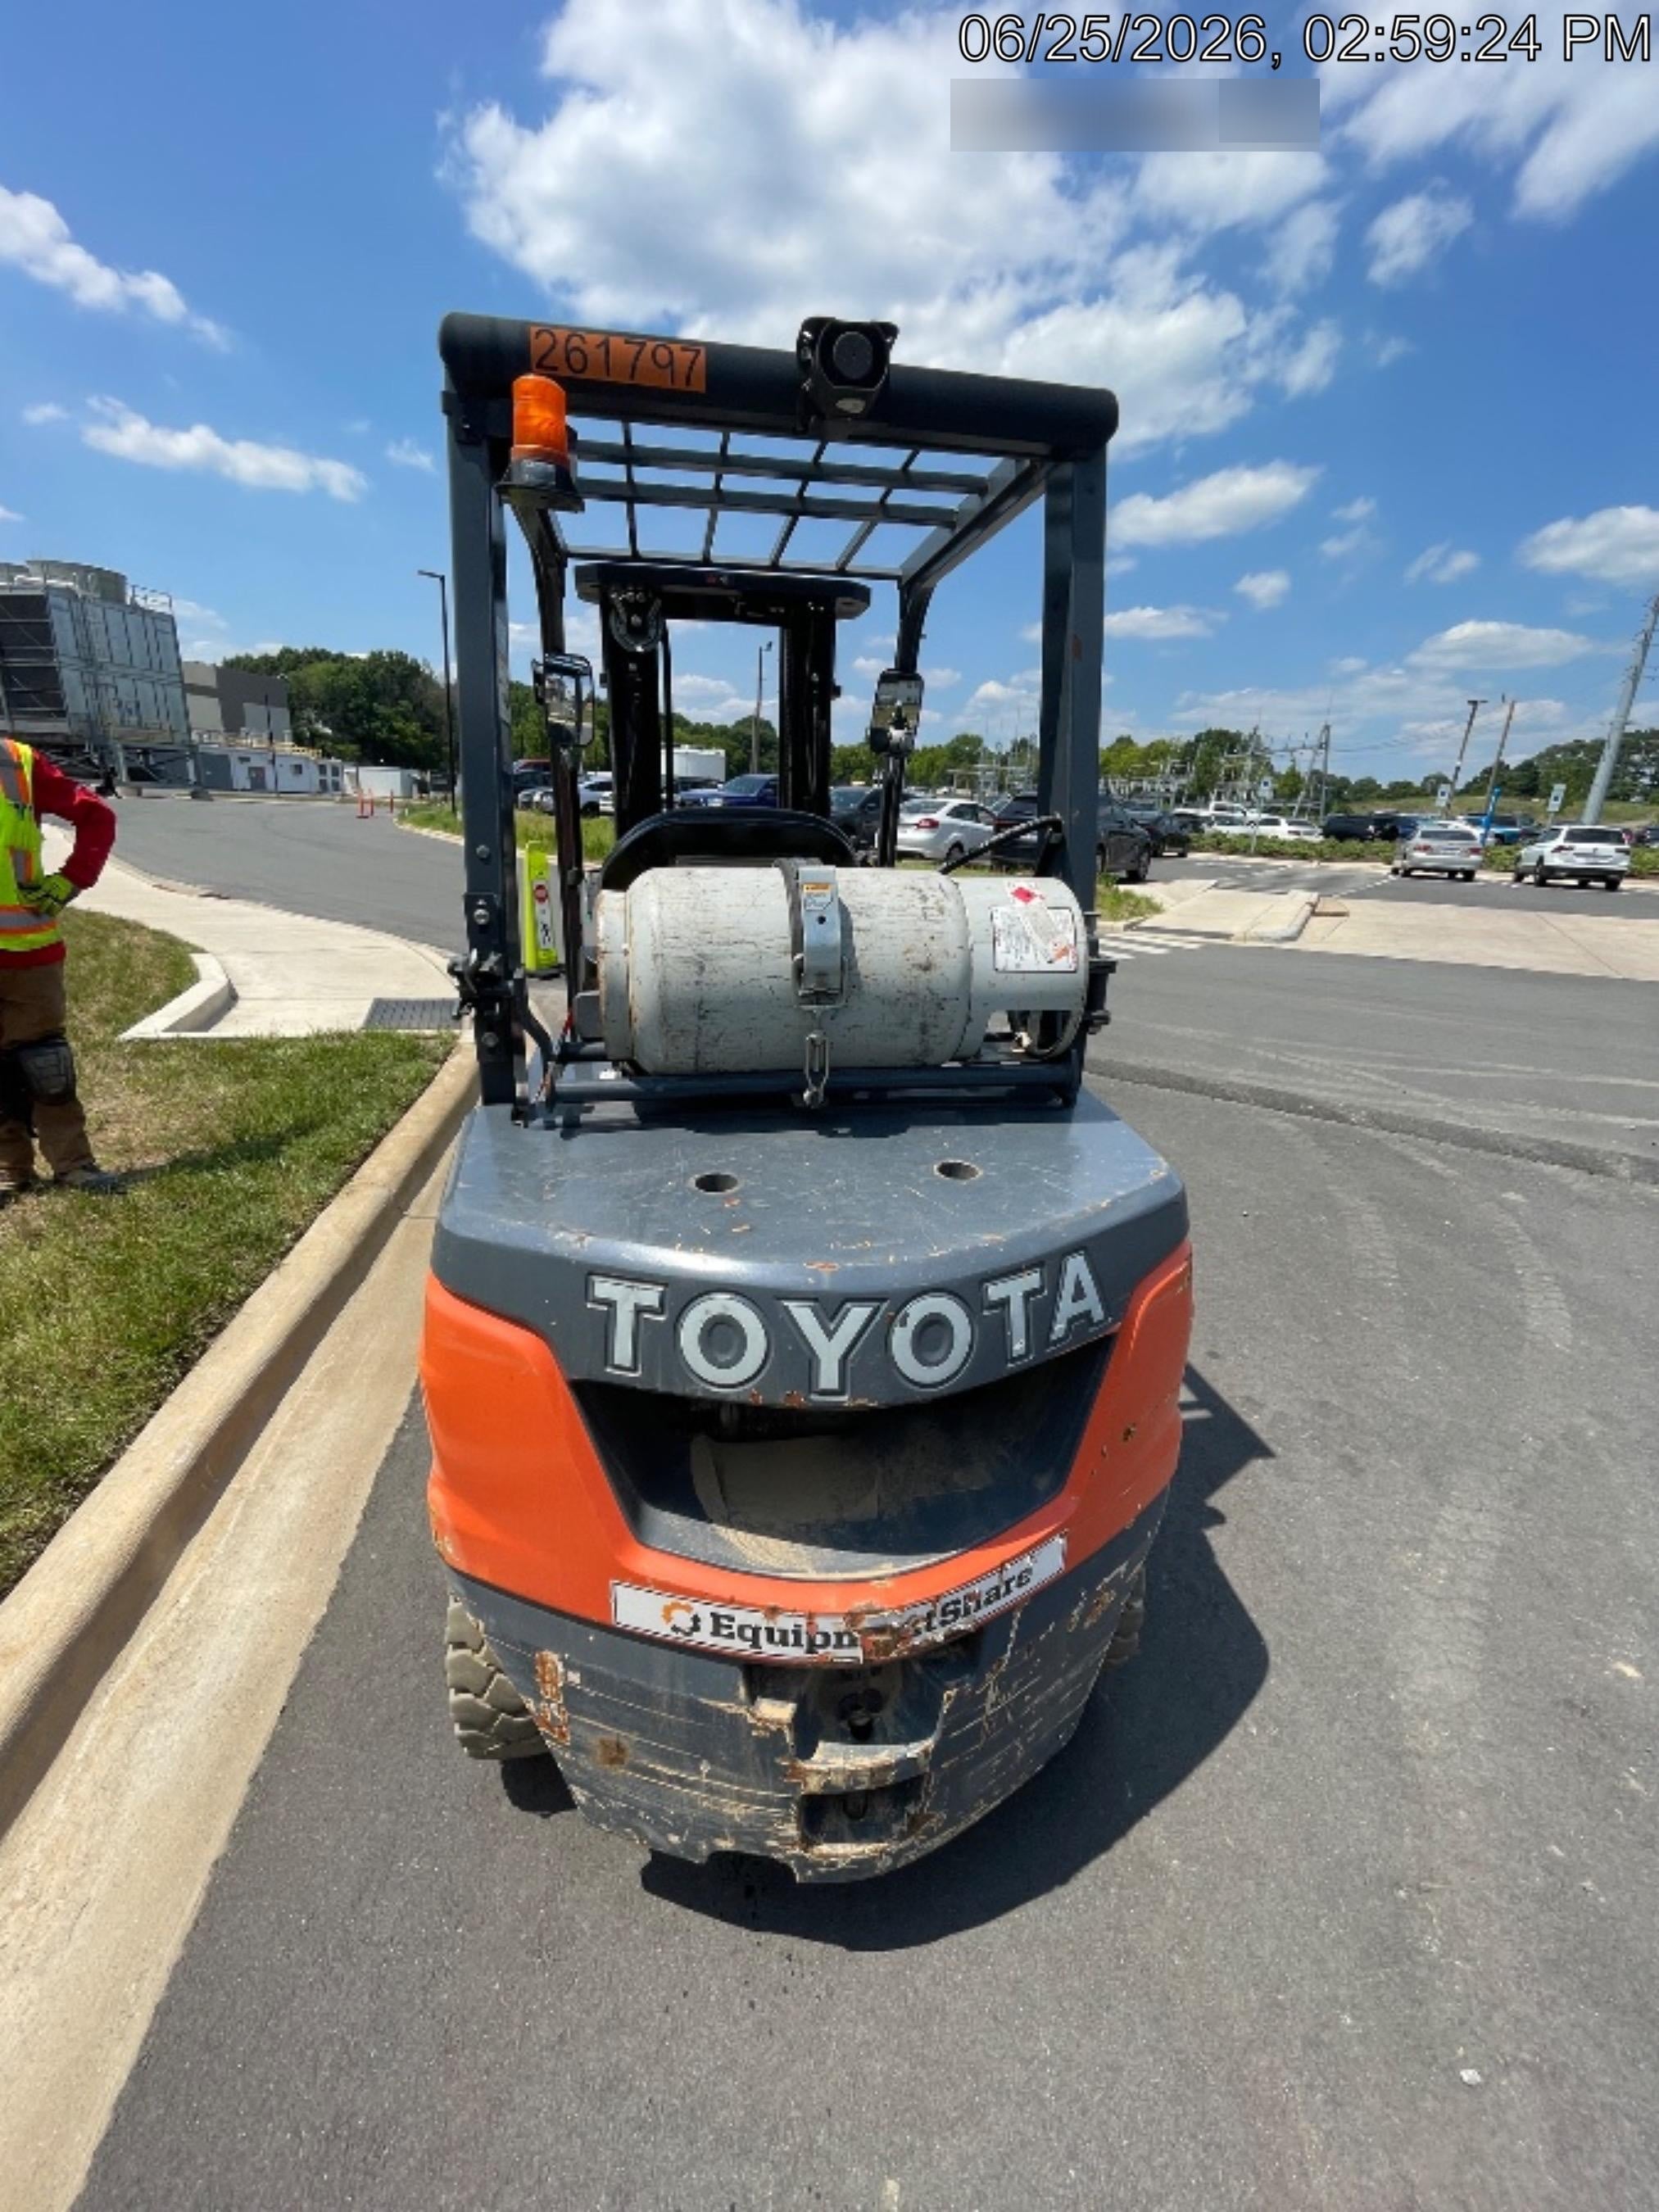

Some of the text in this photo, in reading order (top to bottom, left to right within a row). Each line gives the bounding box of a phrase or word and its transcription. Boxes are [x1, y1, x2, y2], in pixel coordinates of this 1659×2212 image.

[533, 329, 702, 387] 261797
[586, 1250, 1112, 1398] TOYOTA
[709, 1566, 1034, 1655] EquipmtShare
